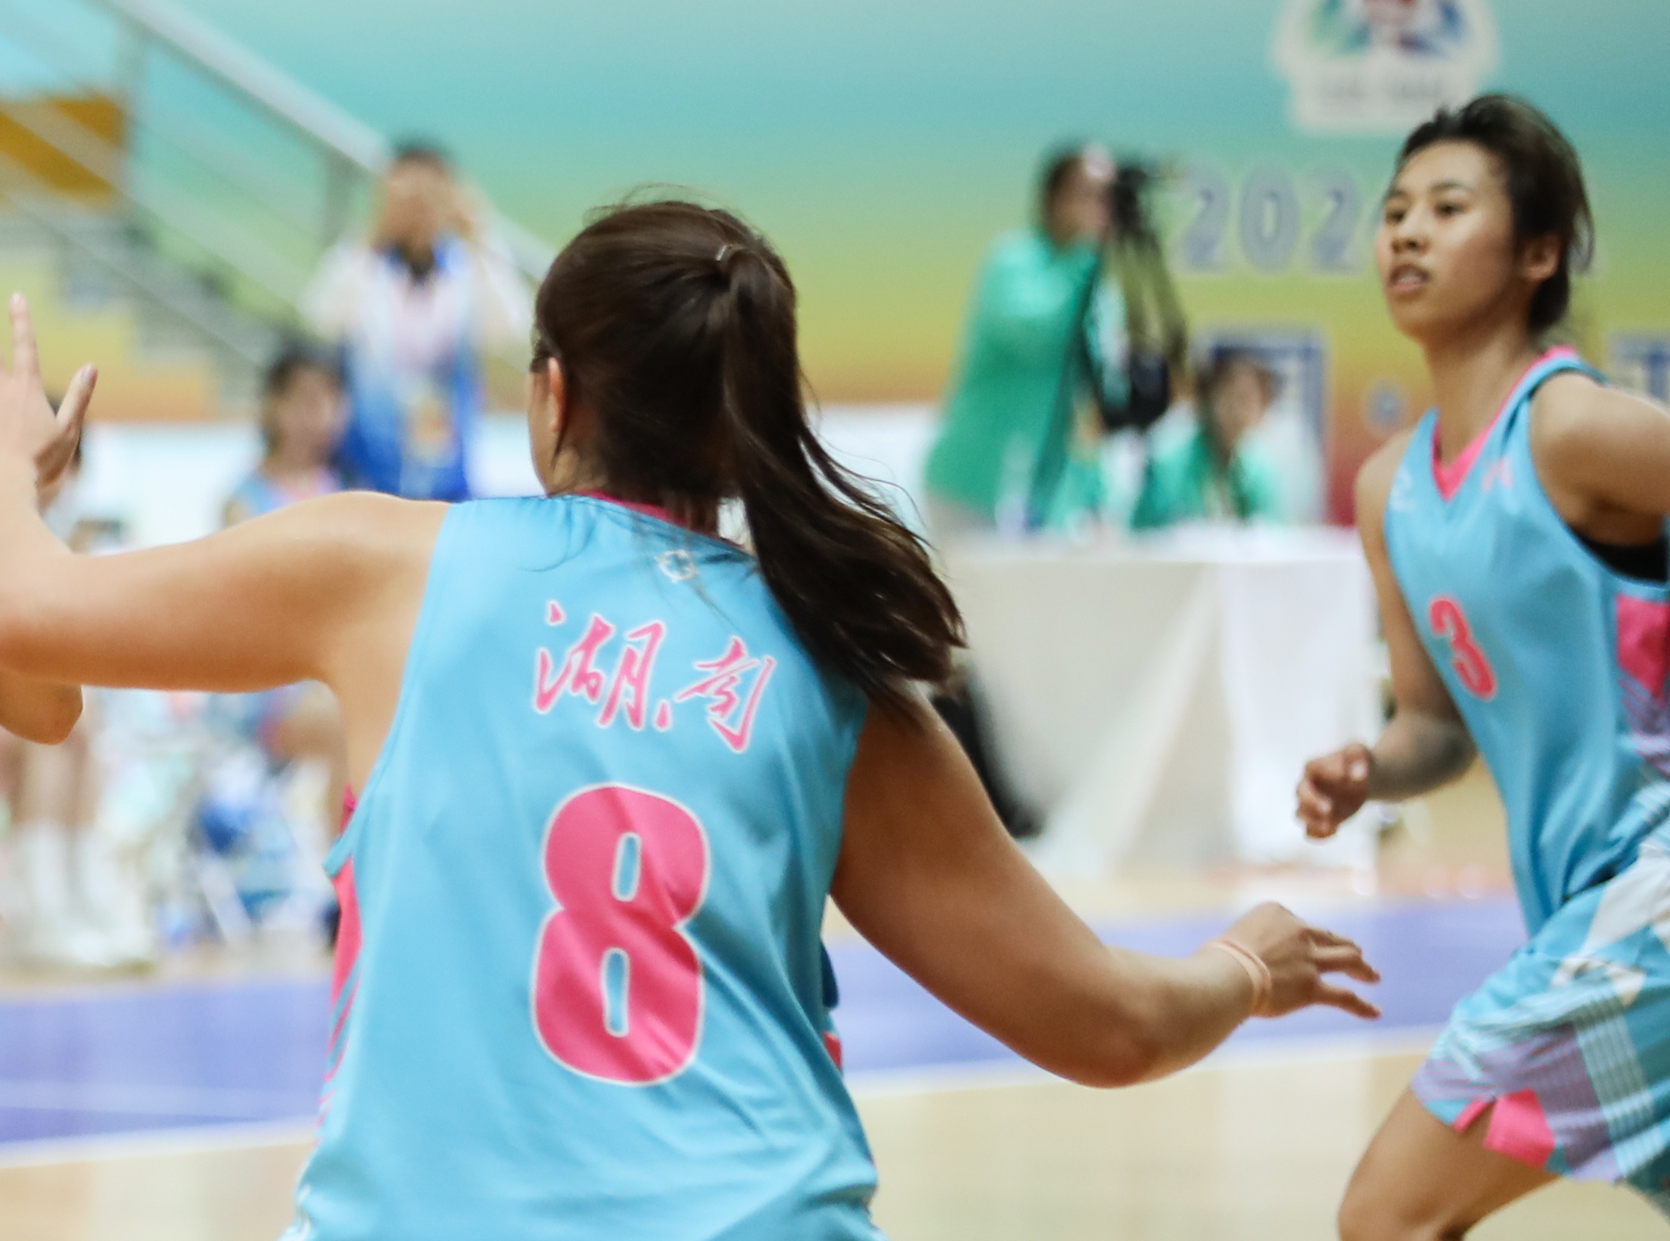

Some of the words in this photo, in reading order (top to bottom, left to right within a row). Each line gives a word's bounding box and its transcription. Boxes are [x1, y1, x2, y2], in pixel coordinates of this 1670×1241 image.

[534, 600, 777, 753] 湖南
[1427, 595, 1498, 701] 3
[534, 783, 712, 1087] 8
